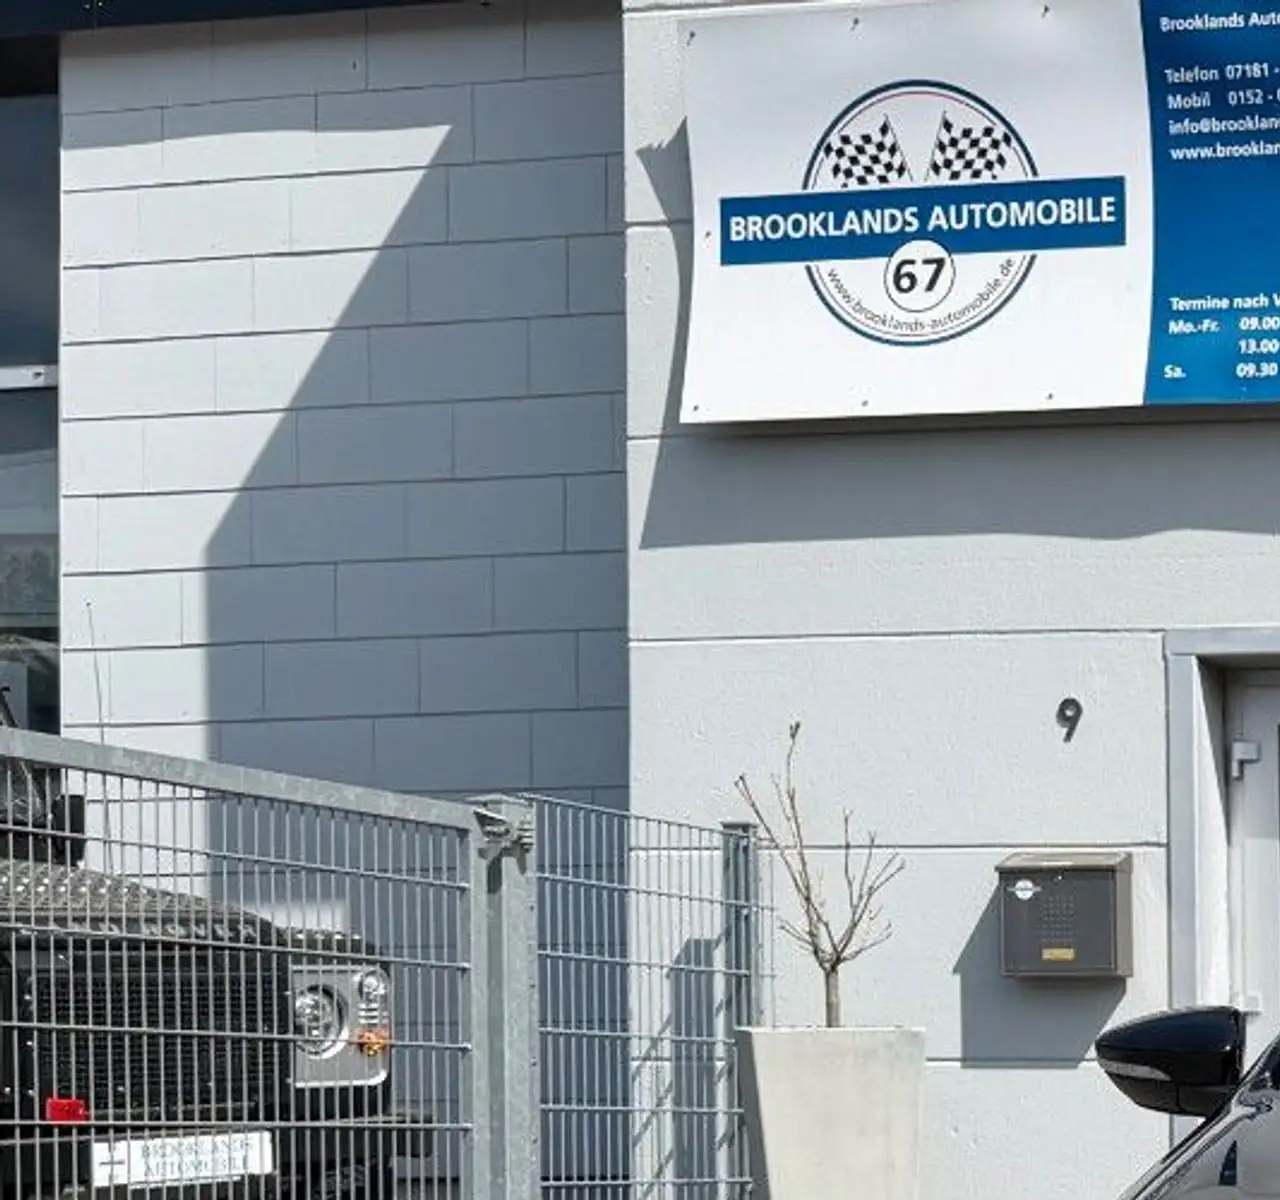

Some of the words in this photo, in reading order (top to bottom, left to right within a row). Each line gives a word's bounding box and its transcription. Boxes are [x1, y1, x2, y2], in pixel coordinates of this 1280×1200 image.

[1160, 12, 1245, 32] Brooklands
[1164, 66, 1219, 84] Telefon
[1225, 63, 1269, 80] 07181
[1167, 92, 1211, 109] Mobil
[1227, 89, 1264, 106] 0152
[729, 206, 919, 241] BROOKLANDS
[928, 196, 1116, 231] AUTOMOBILE
[892, 257, 946, 294] 67
[827, 258, 1015, 331] www.brooklands-automobile.de
[1169, 295, 1230, 311] Termine
[1233, 293, 1269, 309] nach
[1239, 316, 1280, 331] 09.00
[1239, 339, 1280, 354] 13.00
[1164, 364, 1187, 379] Sa.
[1236, 362, 1279, 378] 09.30
[1056, 697, 1083, 744] 9
